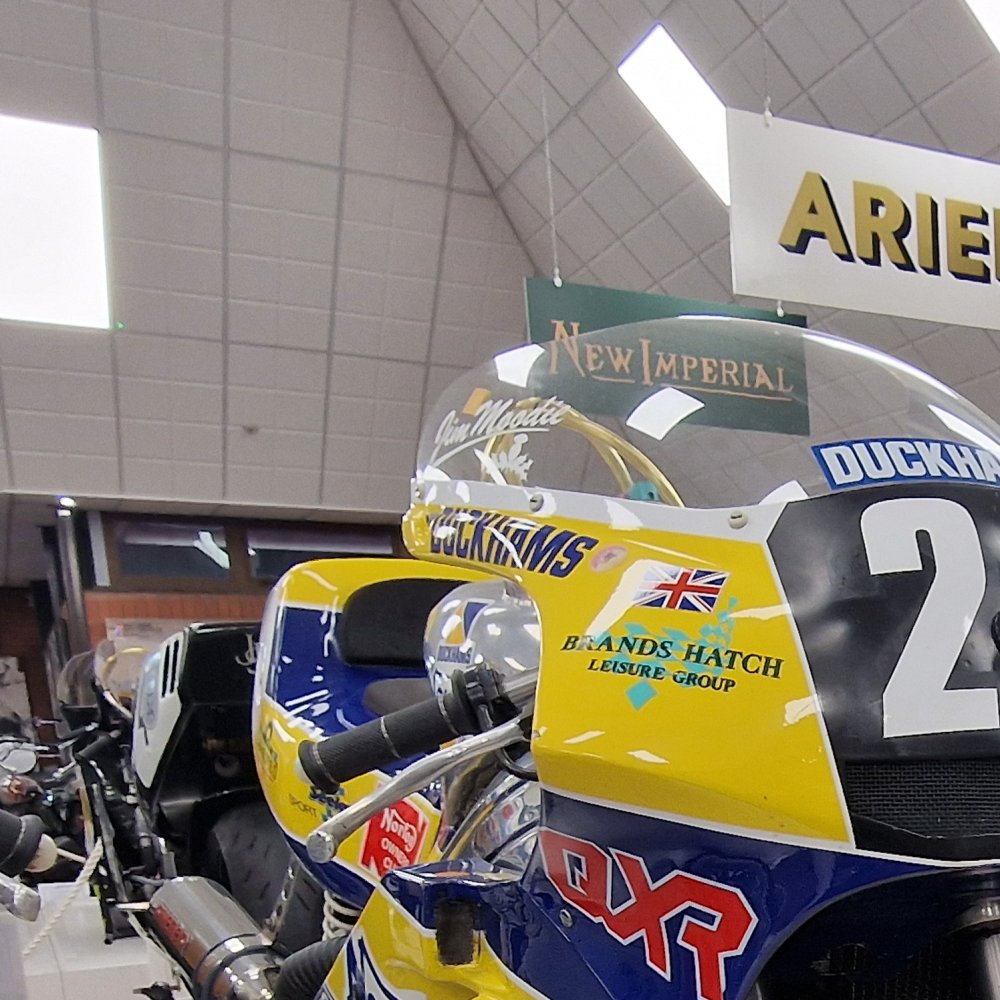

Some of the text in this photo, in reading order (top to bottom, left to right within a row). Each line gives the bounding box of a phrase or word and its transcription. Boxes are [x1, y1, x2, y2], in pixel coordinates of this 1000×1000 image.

[550, 320, 794, 393] NEW IMPERIAL
[561, 634, 784, 679] BRANDS HATCH
[588, 658, 737, 693] LEISURE GROUP
